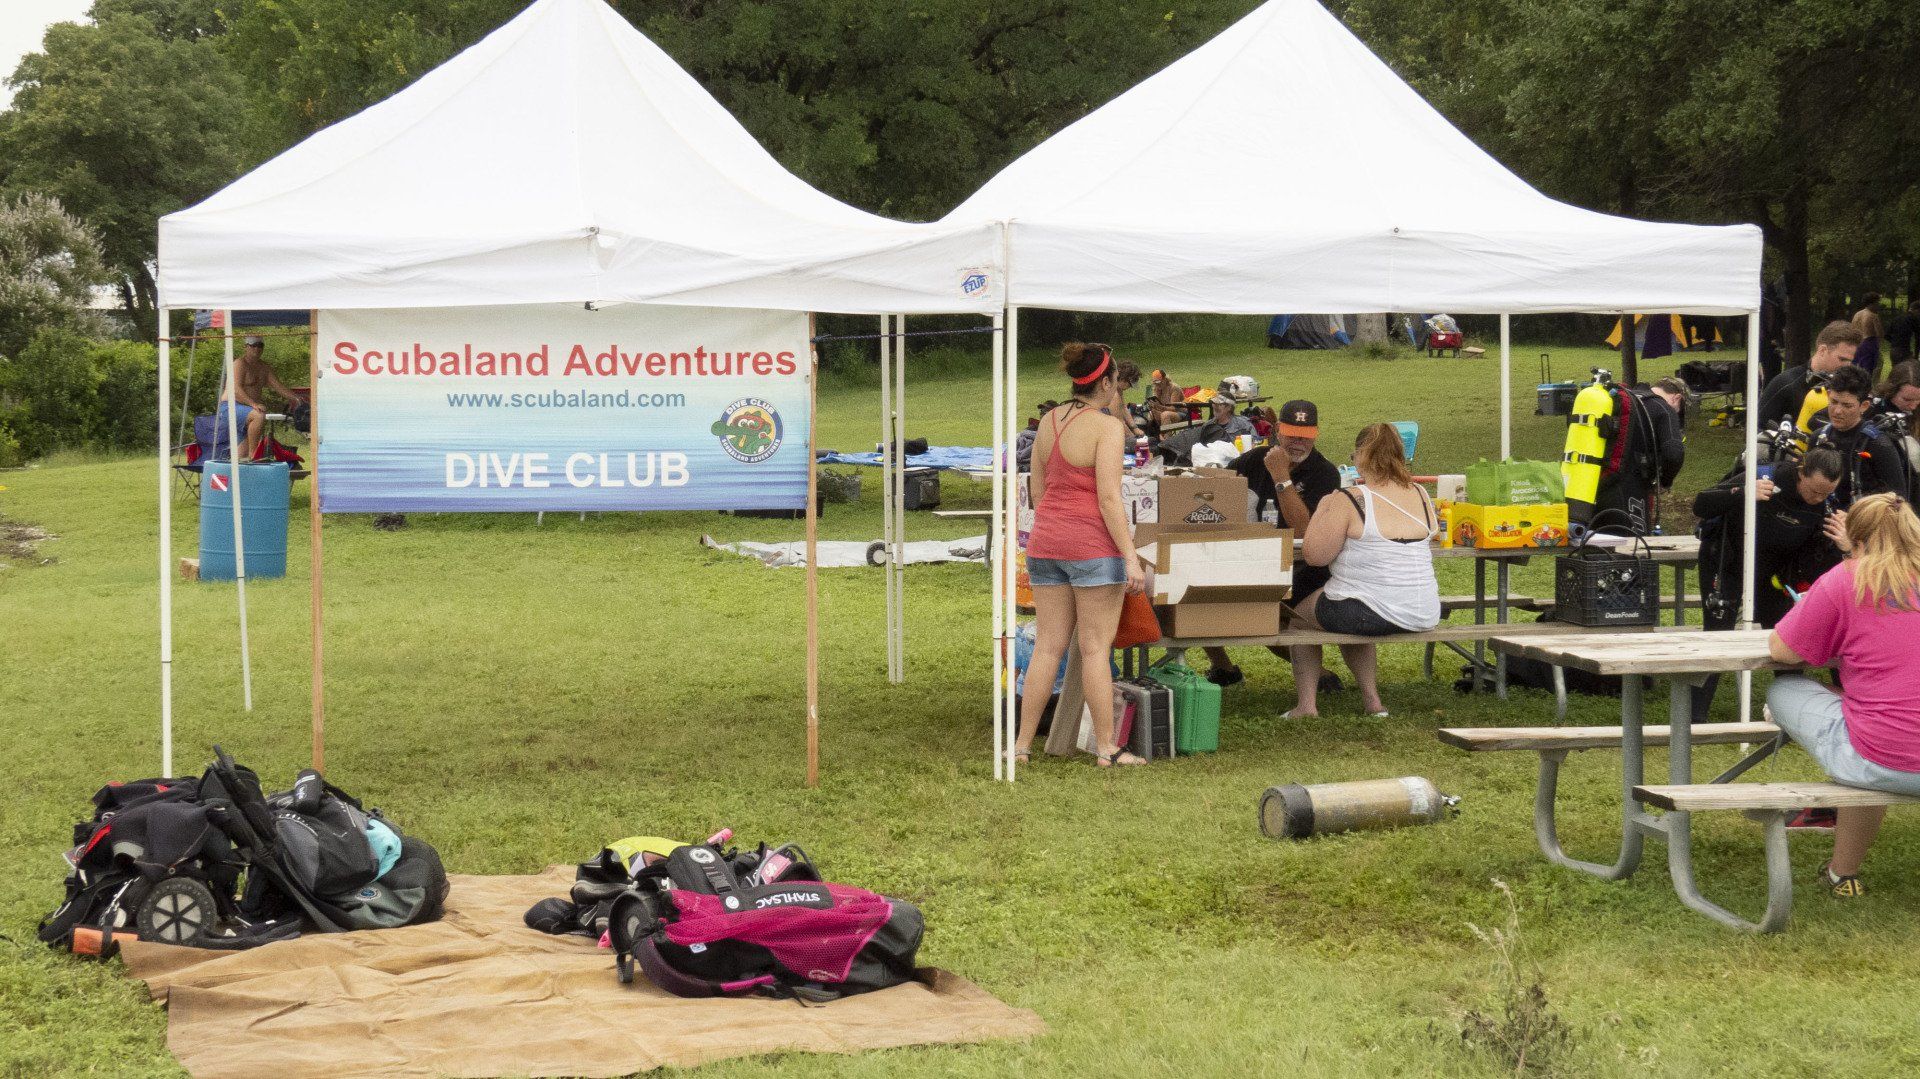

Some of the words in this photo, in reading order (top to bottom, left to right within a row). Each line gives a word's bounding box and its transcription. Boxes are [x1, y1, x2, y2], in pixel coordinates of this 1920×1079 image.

[333, 341, 549, 376] Scubaland
[563, 344, 797, 376] Adventures
[446, 389, 686, 408] www.scubaland.com
[726, 400, 747, 415] DIVE
[750, 399, 775, 415] CLUB
[1295, 411, 1307, 422] H
[446, 453, 550, 487] DIVE
[565, 452, 690, 487] CLUB
[1190, 511, 1221, 524] Ready
[755, 891, 821, 909] STAHLSAC
